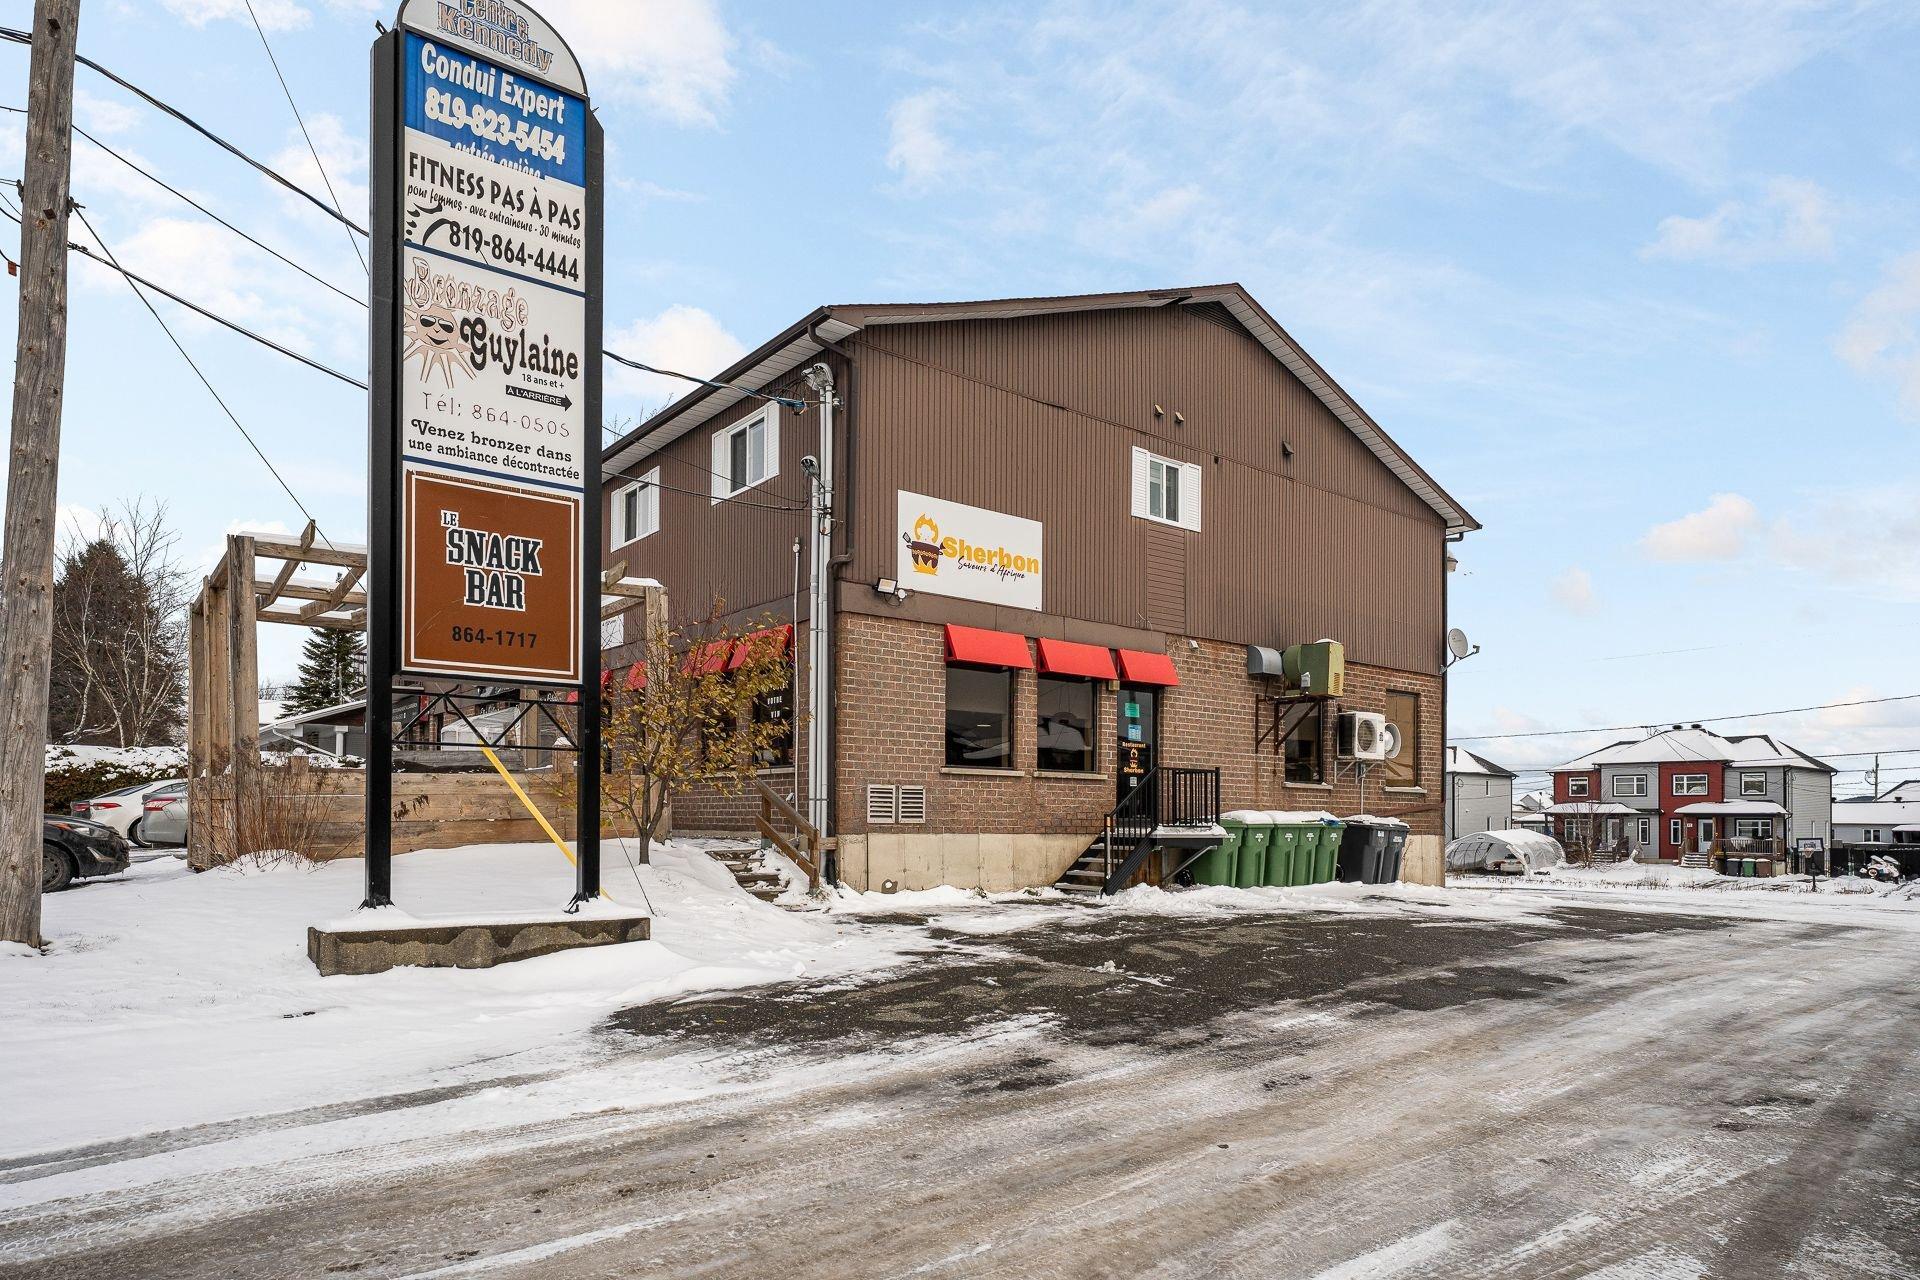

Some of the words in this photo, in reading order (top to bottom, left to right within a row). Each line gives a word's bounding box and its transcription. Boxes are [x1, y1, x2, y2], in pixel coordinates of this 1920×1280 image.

[437, 1, 554, 75] Kennedy
[421, 43, 496, 98] Condui
[500, 73, 564, 124] Expert
[425, 87, 565, 165] 819-823-5454
[409, 152, 485, 199] FITNESS
[491, 180, 524, 212] PAS
[529, 187, 543, 219] À
[549, 199, 581, 231] PAS
[407, 184, 427, 198] pour
[430, 189, 462, 211] femmes
[469, 204, 487, 217] avec
[539, 224, 549, 237] 30
[552, 230, 581, 249] minutes
[449, 220, 579, 282] 819-864-4444
[410, 257, 529, 332] Bronzage
[522, 374, 532, 383] 18
[533, 377, 548, 387] ans
[550, 380, 557, 388] et
[411, 419, 465, 442] Venez
[471, 431, 531, 453] bronzer
[537, 445, 572, 462] dans
[472, 404, 570, 437] 864-0505
[408, 439, 432, 451] une
[437, 444, 498, 464] ambiance
[503, 455, 580, 480] décontractée
[441, 510, 458, 527] LE
[446, 528, 543, 576] SNACK
[943, 536, 1039, 574] Sherbon
[958, 556, 987, 572] Saveurs
[464, 567, 526, 611] BAR
[452, 626, 537, 648] 864-1717
